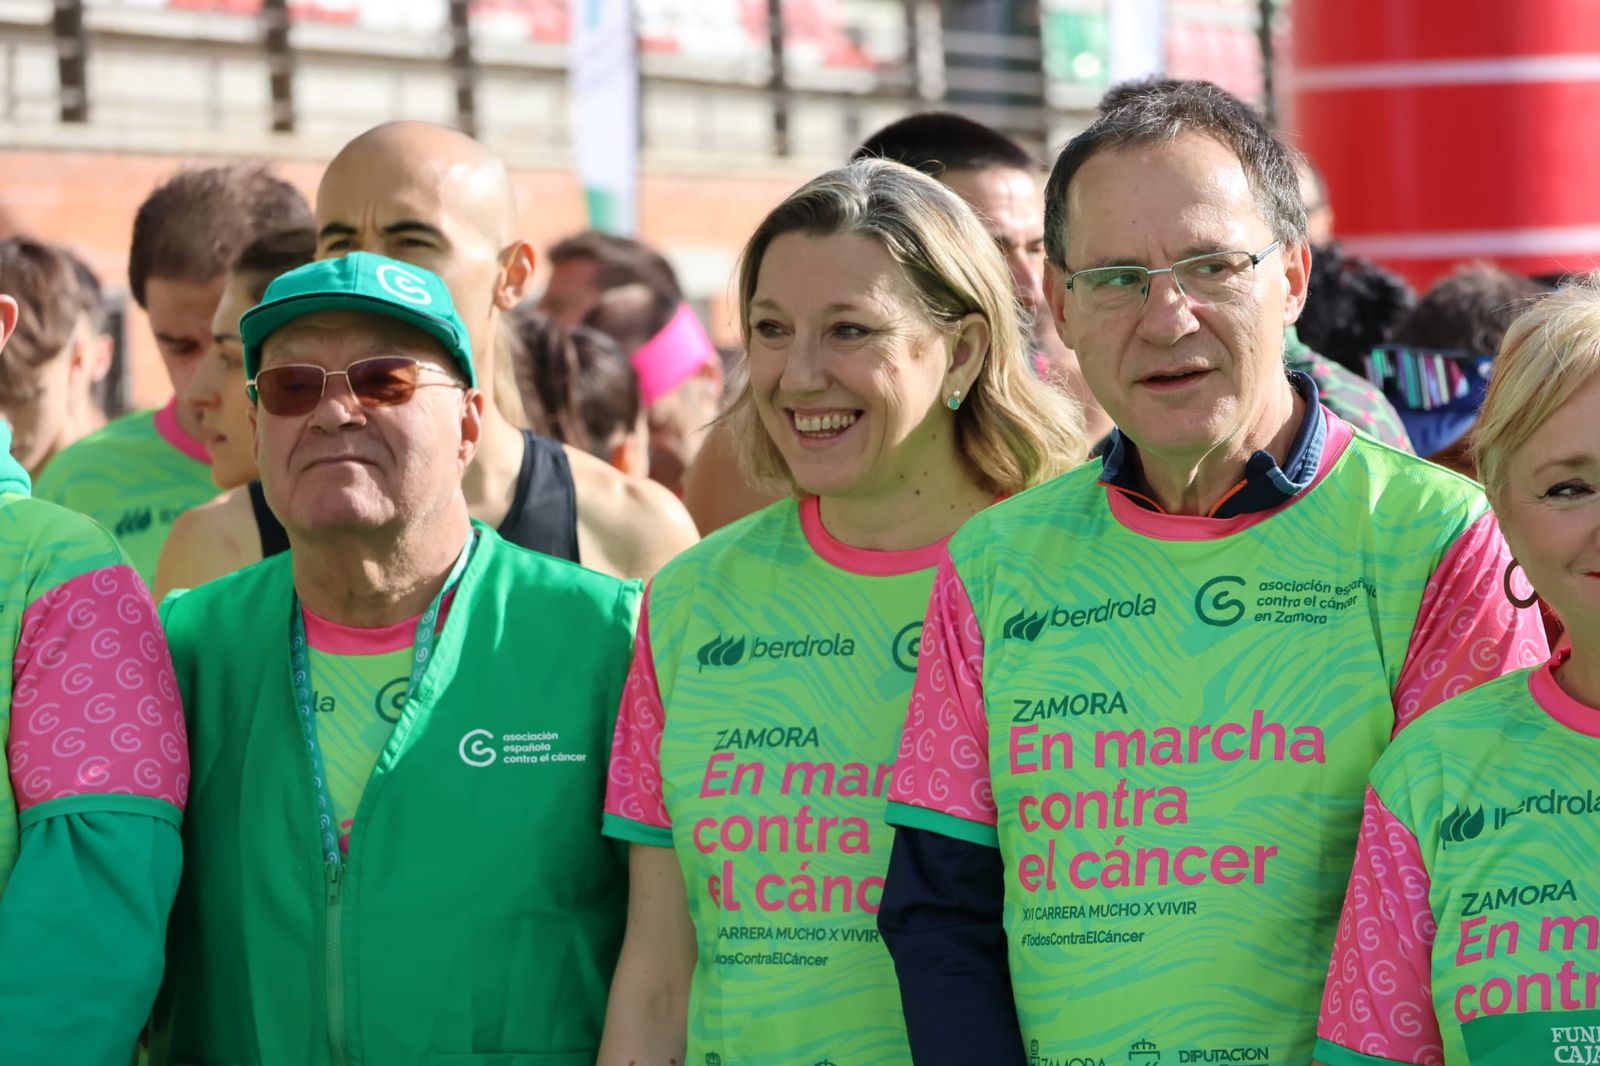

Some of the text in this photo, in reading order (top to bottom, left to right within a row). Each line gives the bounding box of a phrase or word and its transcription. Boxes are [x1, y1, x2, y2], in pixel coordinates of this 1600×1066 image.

[1259, 579, 1331, 593] asociación
[1049, 593, 1156, 627] berdrola
[1257, 596, 1301, 608] contra
[1303, 595, 1317, 608] el
[1254, 611, 1327, 624] en Zamora
[1012, 691, 1128, 722] ZAMORA
[503, 731, 559, 741] asociación
[503, 742, 551, 754] española
[713, 727, 819, 751] ZAMORA
[1009, 709, 1326, 775] En marcha
[503, 752, 586, 763] contra el cáncer
[700, 752, 897, 798] En mar
[1018, 778, 1188, 833] contra
[693, 805, 870, 854] contra
[1018, 835, 1278, 892] el cáncer
[755, 861, 886, 914] cánc
[1461, 879, 1577, 917] ZAMORA
[1035, 906, 1085, 920] CARRERA
[1089, 903, 1141, 918] MUCHO
[1144, 903, 1155, 915] X
[1156, 901, 1197, 915] VIVIR
[718, 926, 879, 943] ARRERA MUCHO X VIVIR
[1021, 930, 1145, 947] #TodosContraElCáncer
[1456, 914, 1600, 966] En m
[1454, 961, 1600, 1023] contr
[1550, 1026, 1600, 1043] FUN
